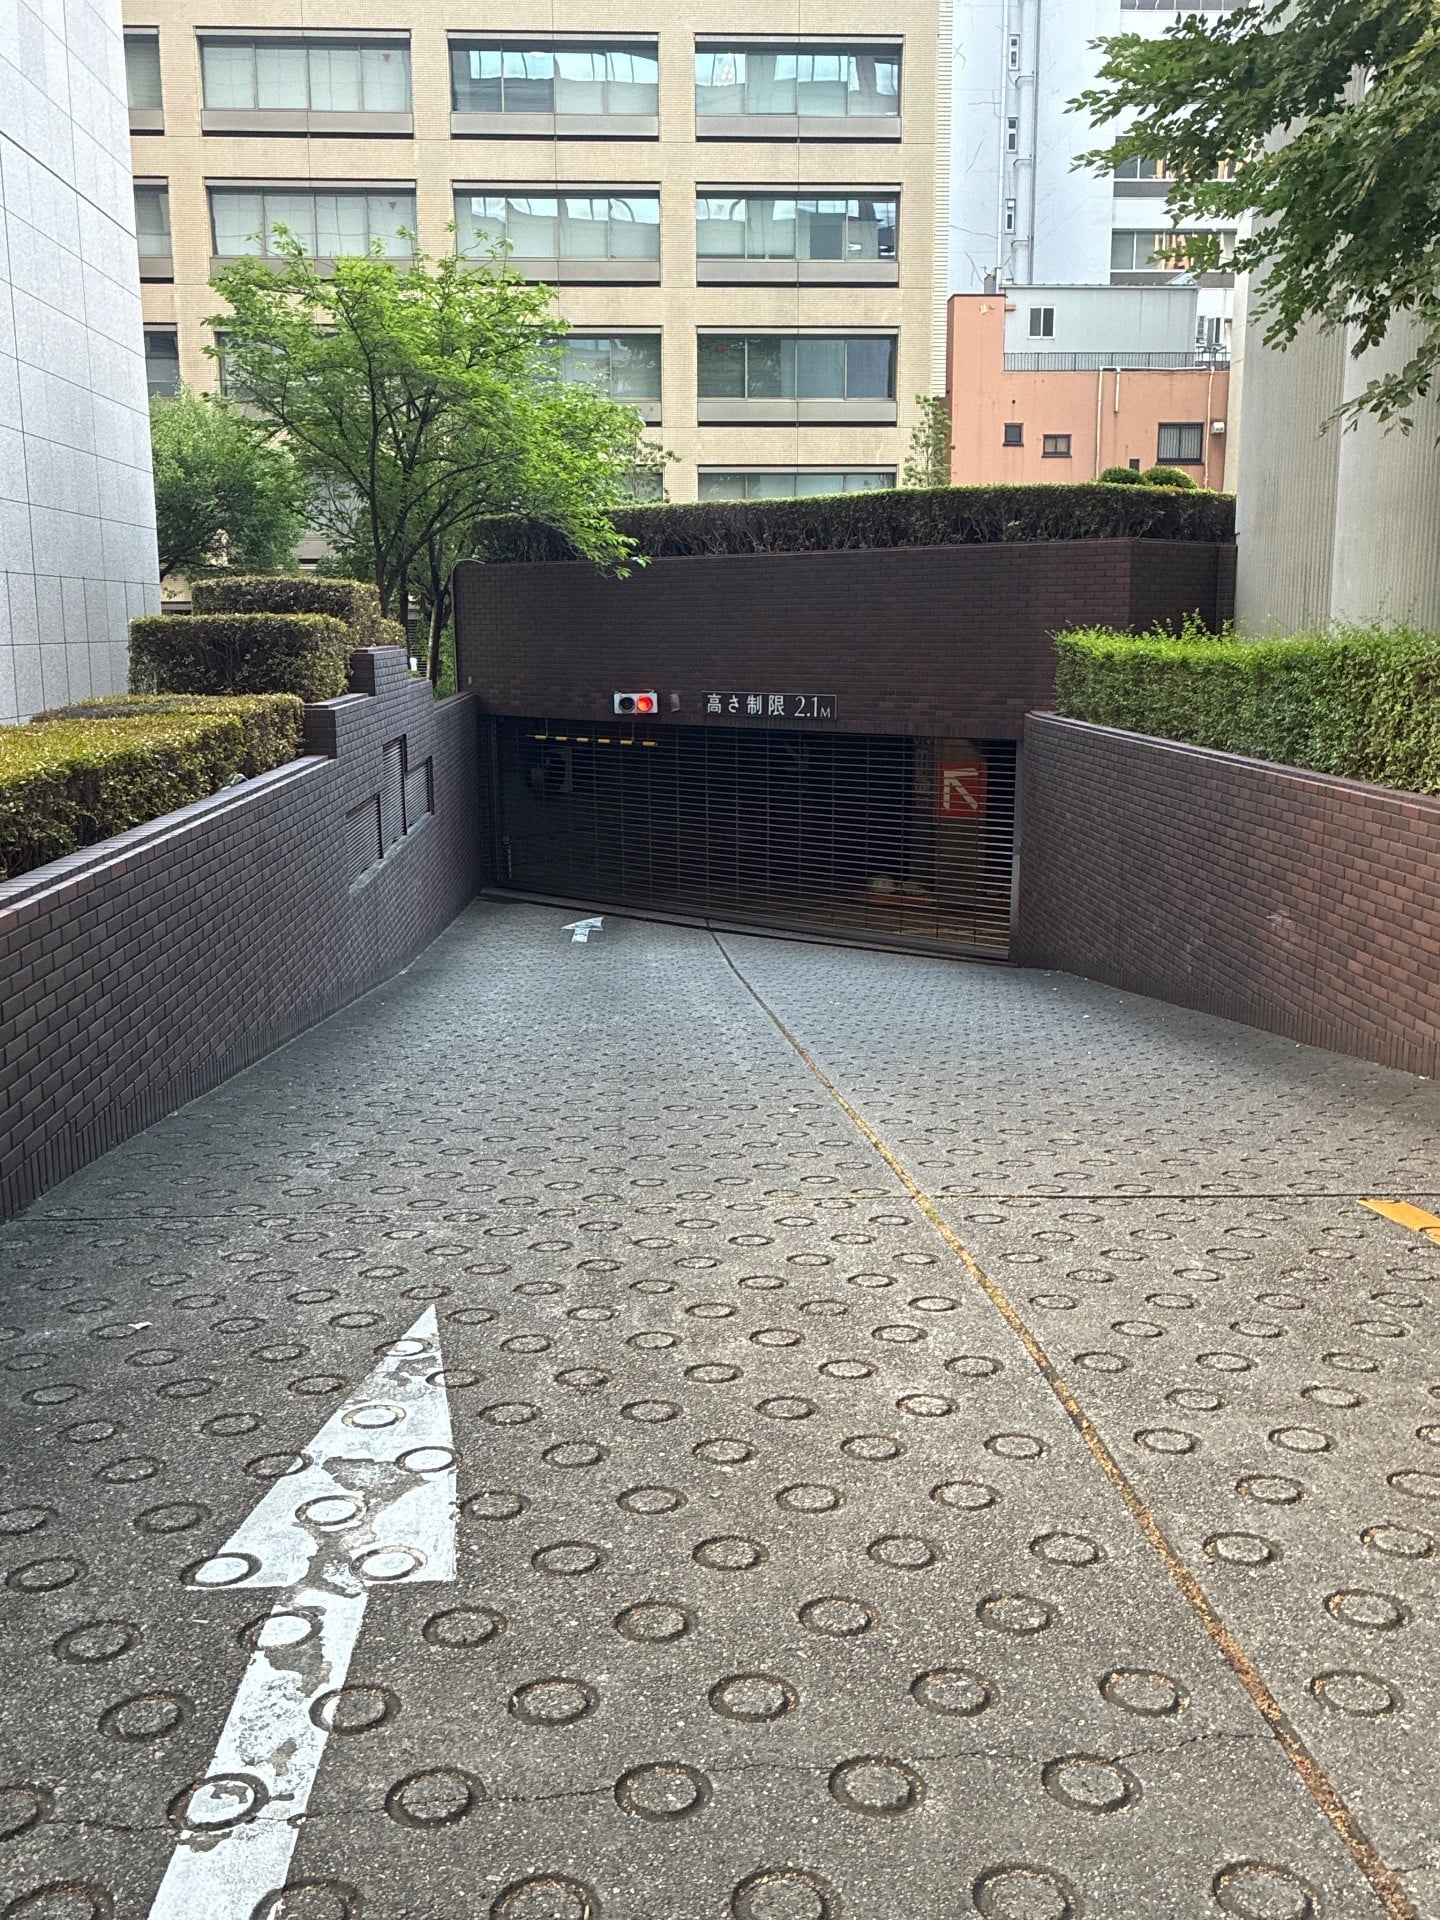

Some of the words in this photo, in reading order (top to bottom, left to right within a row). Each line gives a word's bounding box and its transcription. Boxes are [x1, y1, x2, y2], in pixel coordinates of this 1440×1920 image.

[707, 693, 785, 715] 高さ制限
[794, 696, 831, 718] 2.1M
